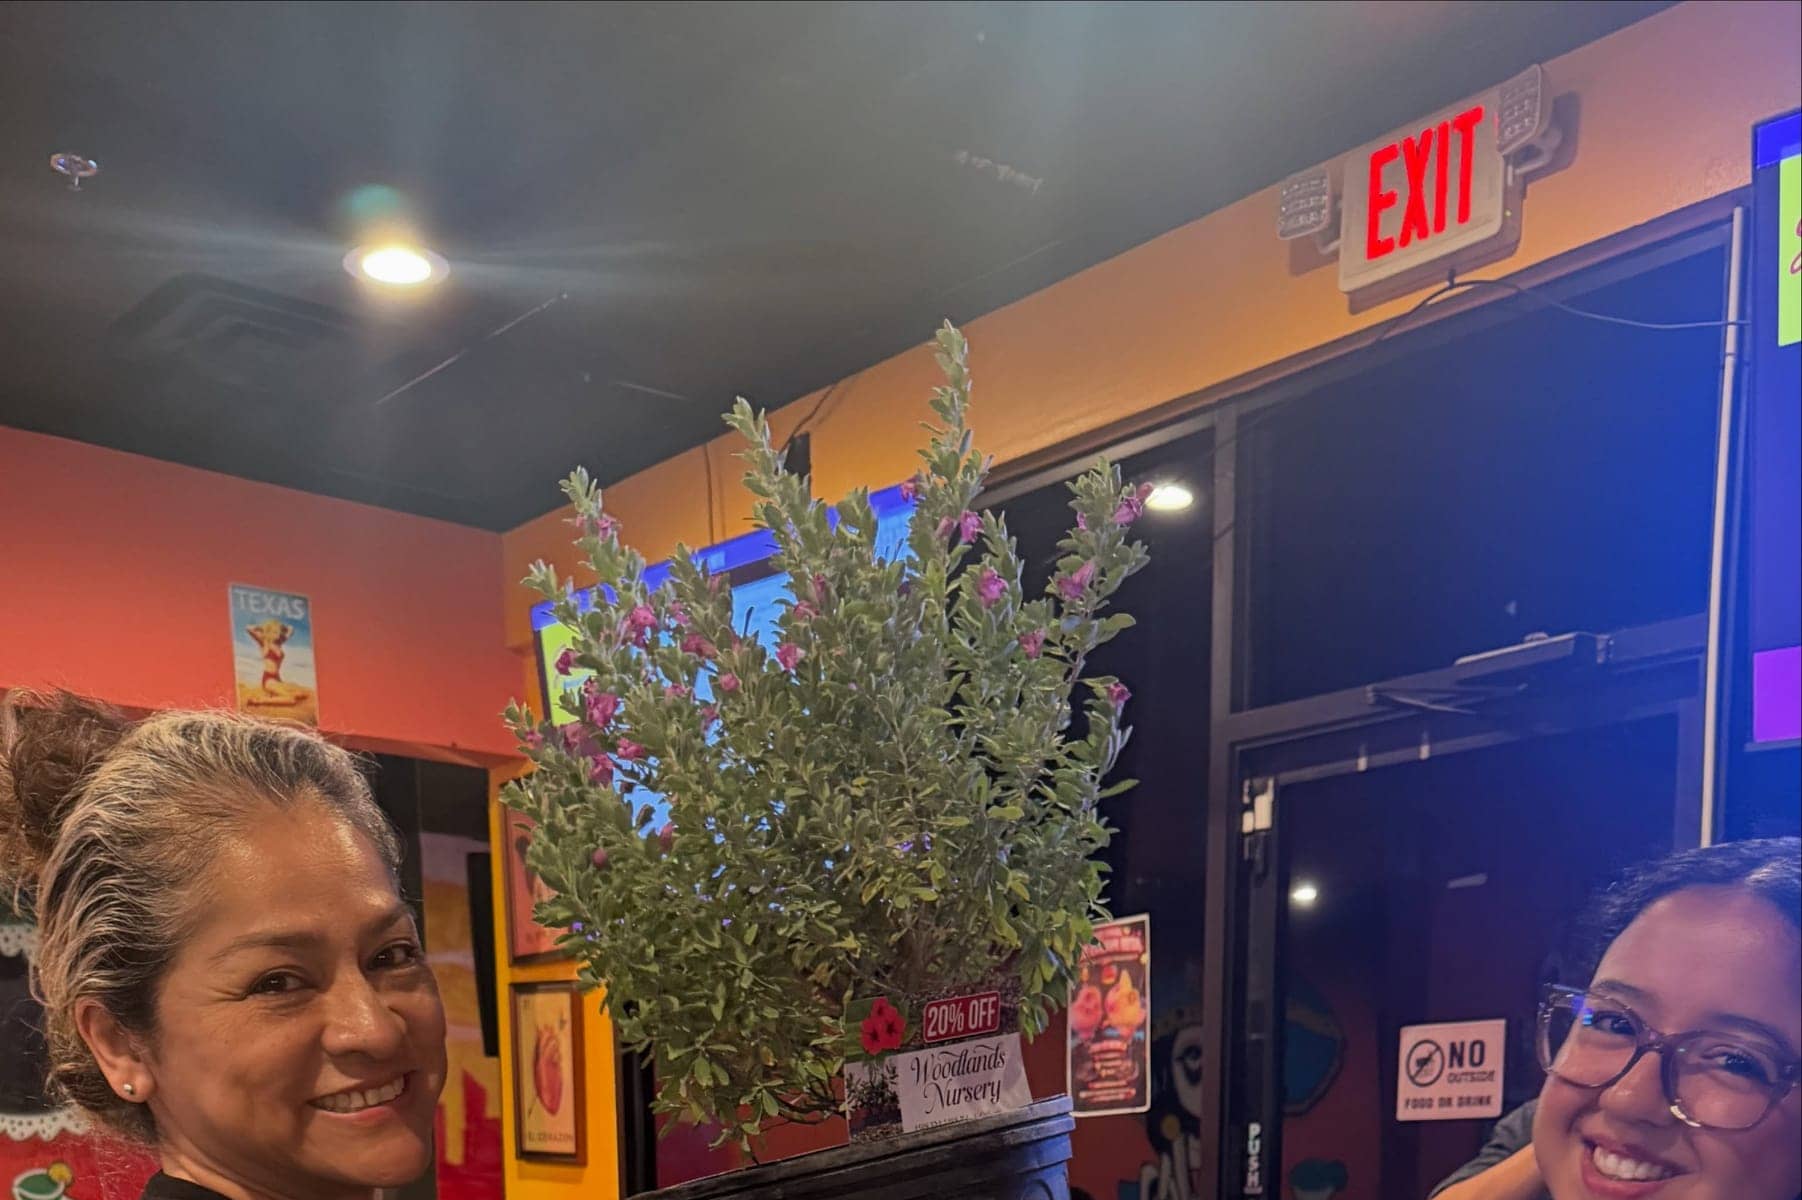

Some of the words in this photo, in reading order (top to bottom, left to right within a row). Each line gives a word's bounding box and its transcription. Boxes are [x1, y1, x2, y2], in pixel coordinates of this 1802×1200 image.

[1365, 104, 1485, 261] EXIT
[235, 586, 305, 620] TEXAS
[927, 1003, 964, 1038] 20%
[968, 996, 997, 1030] OFF
[911, 1042, 1006, 1085] Woodlands
[1448, 1040, 1486, 1069] NO
[1446, 1070, 1495, 1084] OUTSIDE
[923, 1079, 1002, 1115] Nursery
[1404, 1097, 1434, 1109] FOOD
[1438, 1096, 1453, 1108] OR
[1457, 1095, 1492, 1107] DRINK
[1246, 1122, 1261, 1188] PUSH
